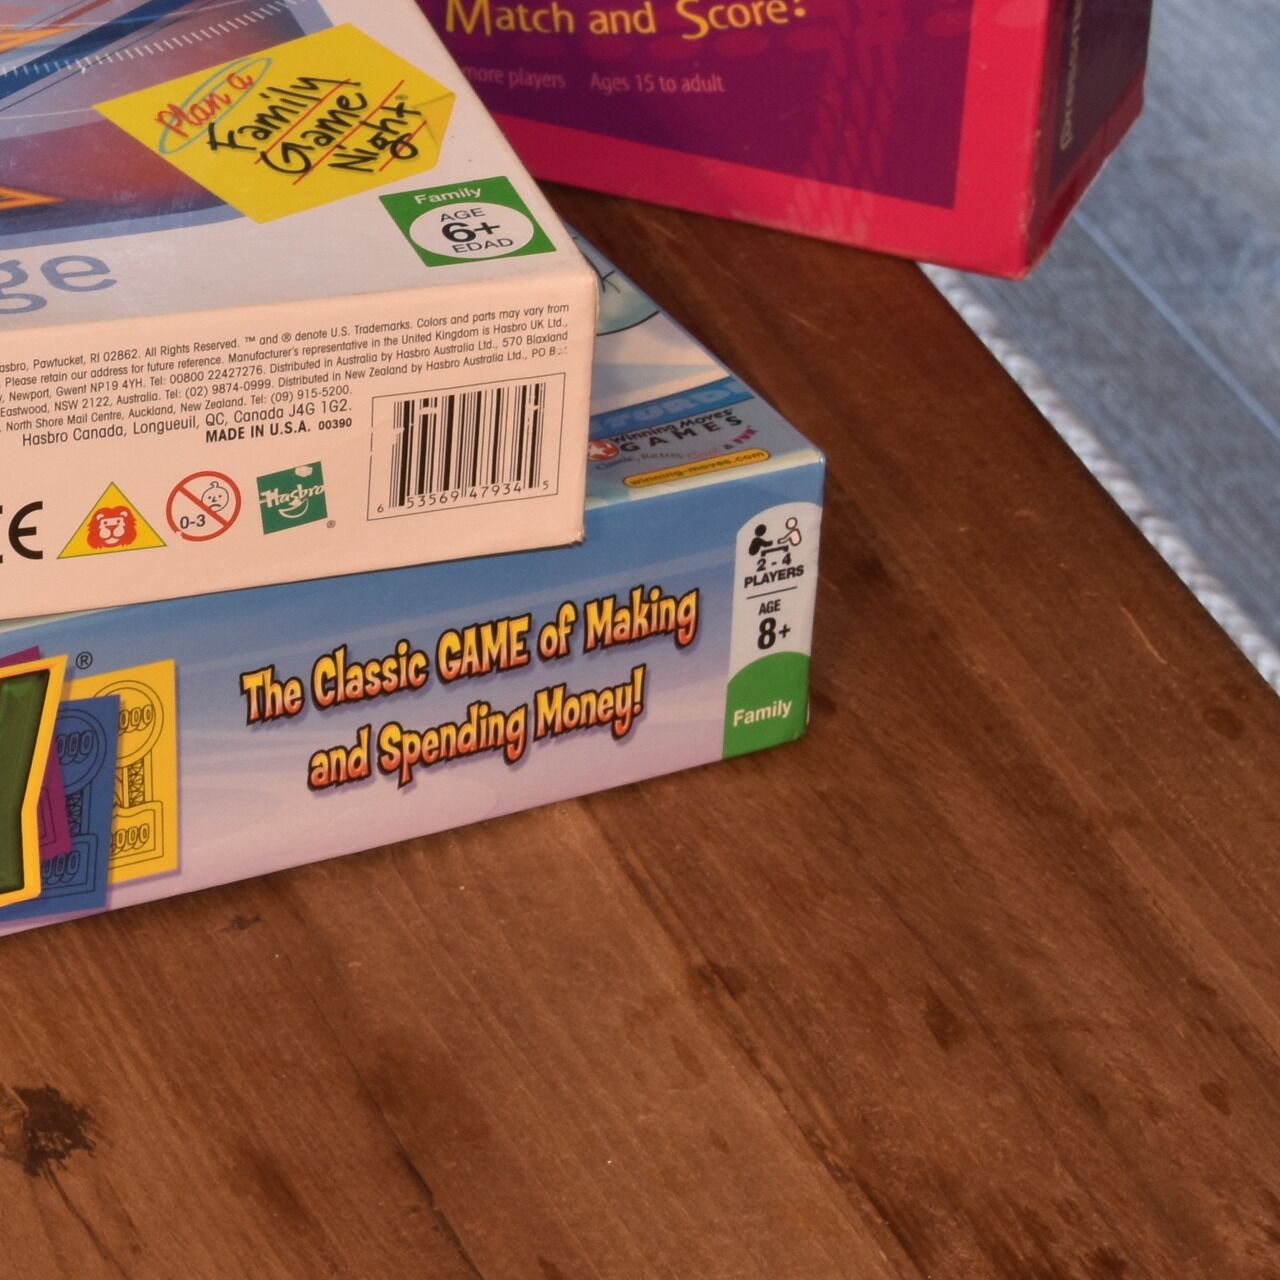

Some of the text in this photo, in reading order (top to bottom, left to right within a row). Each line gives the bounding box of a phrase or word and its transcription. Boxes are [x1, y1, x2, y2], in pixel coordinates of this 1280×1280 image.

[588, 1, 656, 35] and
[509, 66, 724, 96] players Ages 15 to adult
[155, 91, 232, 138] Plan
[206, 76, 361, 151] Family
[260, 92, 367, 174] Game
[328, 101, 422, 172] Night
[414, 186, 482, 205] Family
[440, 207, 486, 223] AGE
[442, 221, 501, 243] 6+
[452, 237, 514, 254] EDAD
[22, 398, 352, 448] Hasbro Canada, Longueuil, QC, Canada J4G 1G2.
[205, 418, 352, 443] MADE IN U.S.A. 00390
[257, 482, 326, 508] Hasbro
[179, 513, 206, 530] 0-3
[744, 565, 804, 588] PLAYERS
[758, 599, 781, 616] AGE
[757, 617, 791, 650] 8+
[241, 585, 699, 723] The Classic GAME of Making
[733, 700, 792, 727] Family
[308, 666, 646, 790] and Spending Money!
